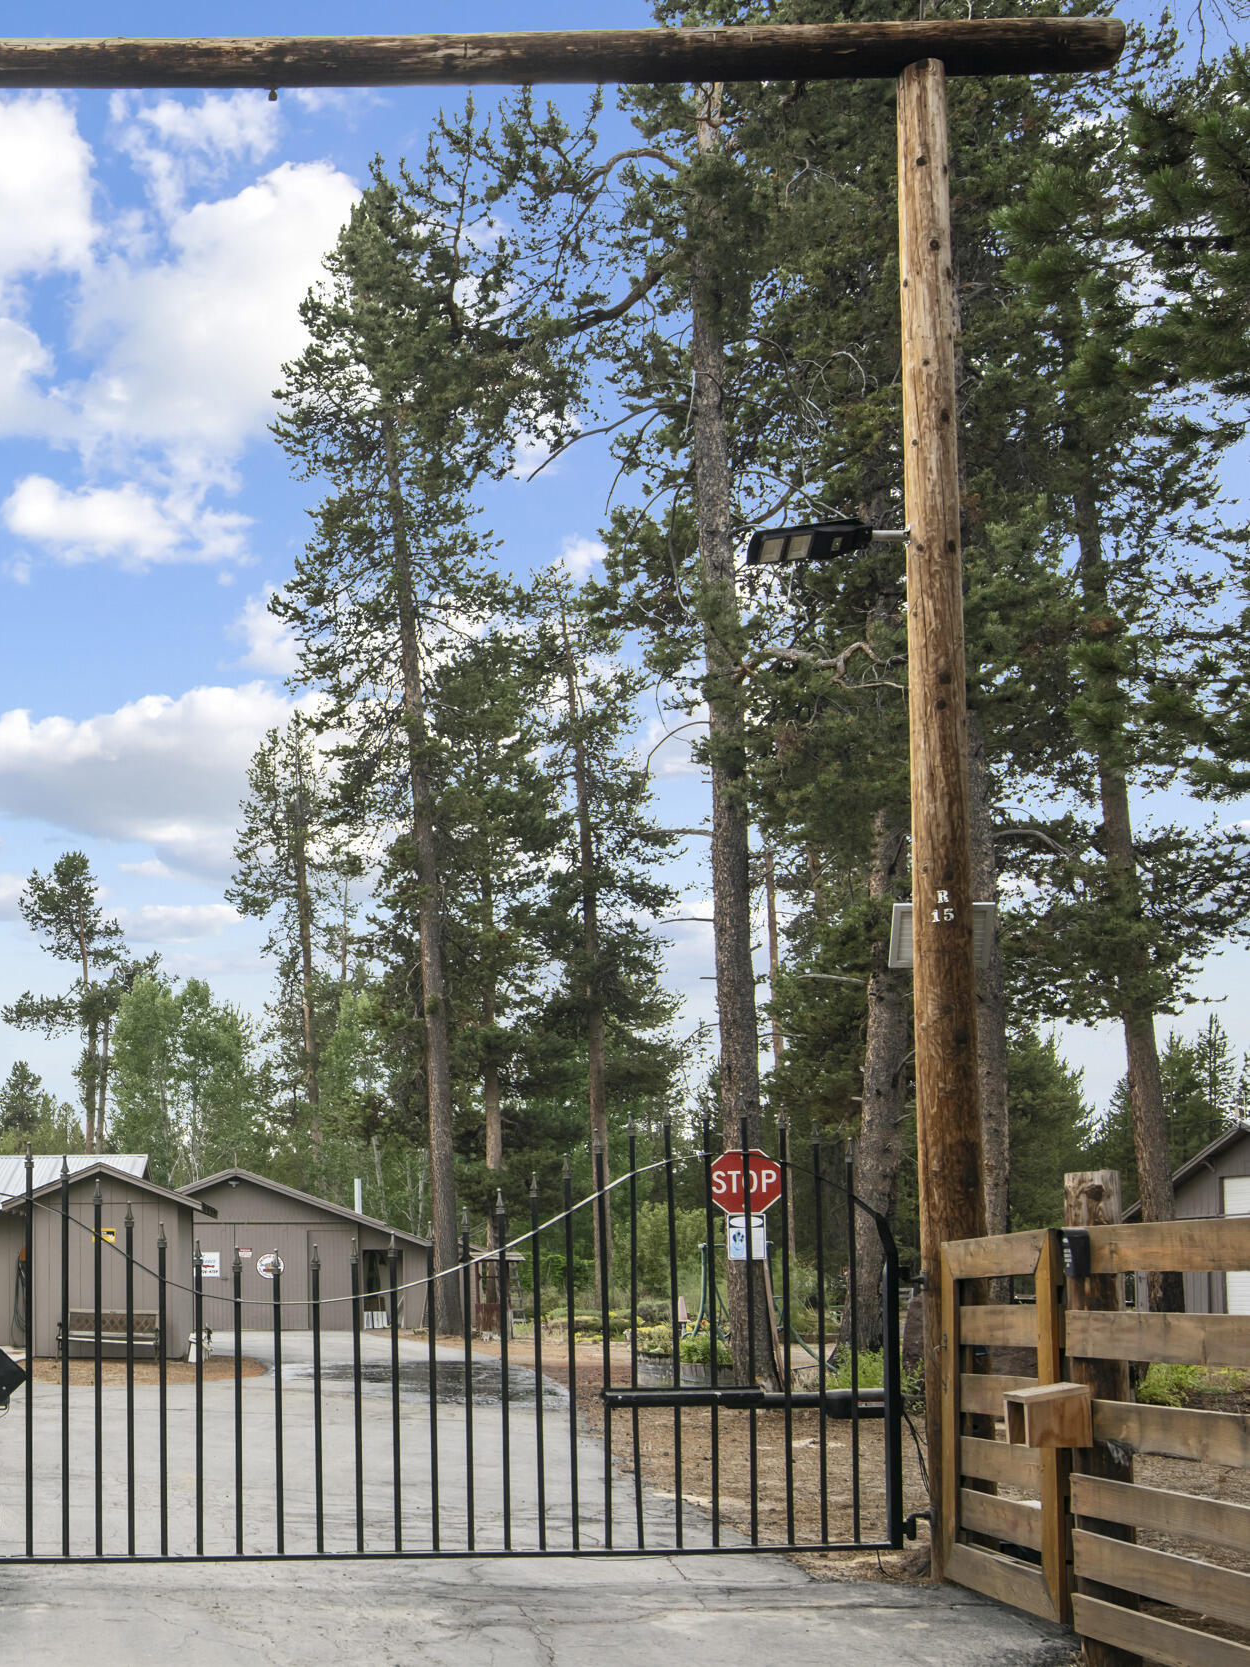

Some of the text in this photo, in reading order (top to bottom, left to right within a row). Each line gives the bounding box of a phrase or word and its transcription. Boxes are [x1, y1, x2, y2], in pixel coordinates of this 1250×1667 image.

[936, 890, 949, 904] R
[931, 908, 954, 922] 15
[712, 1170, 776, 1194] STOP
